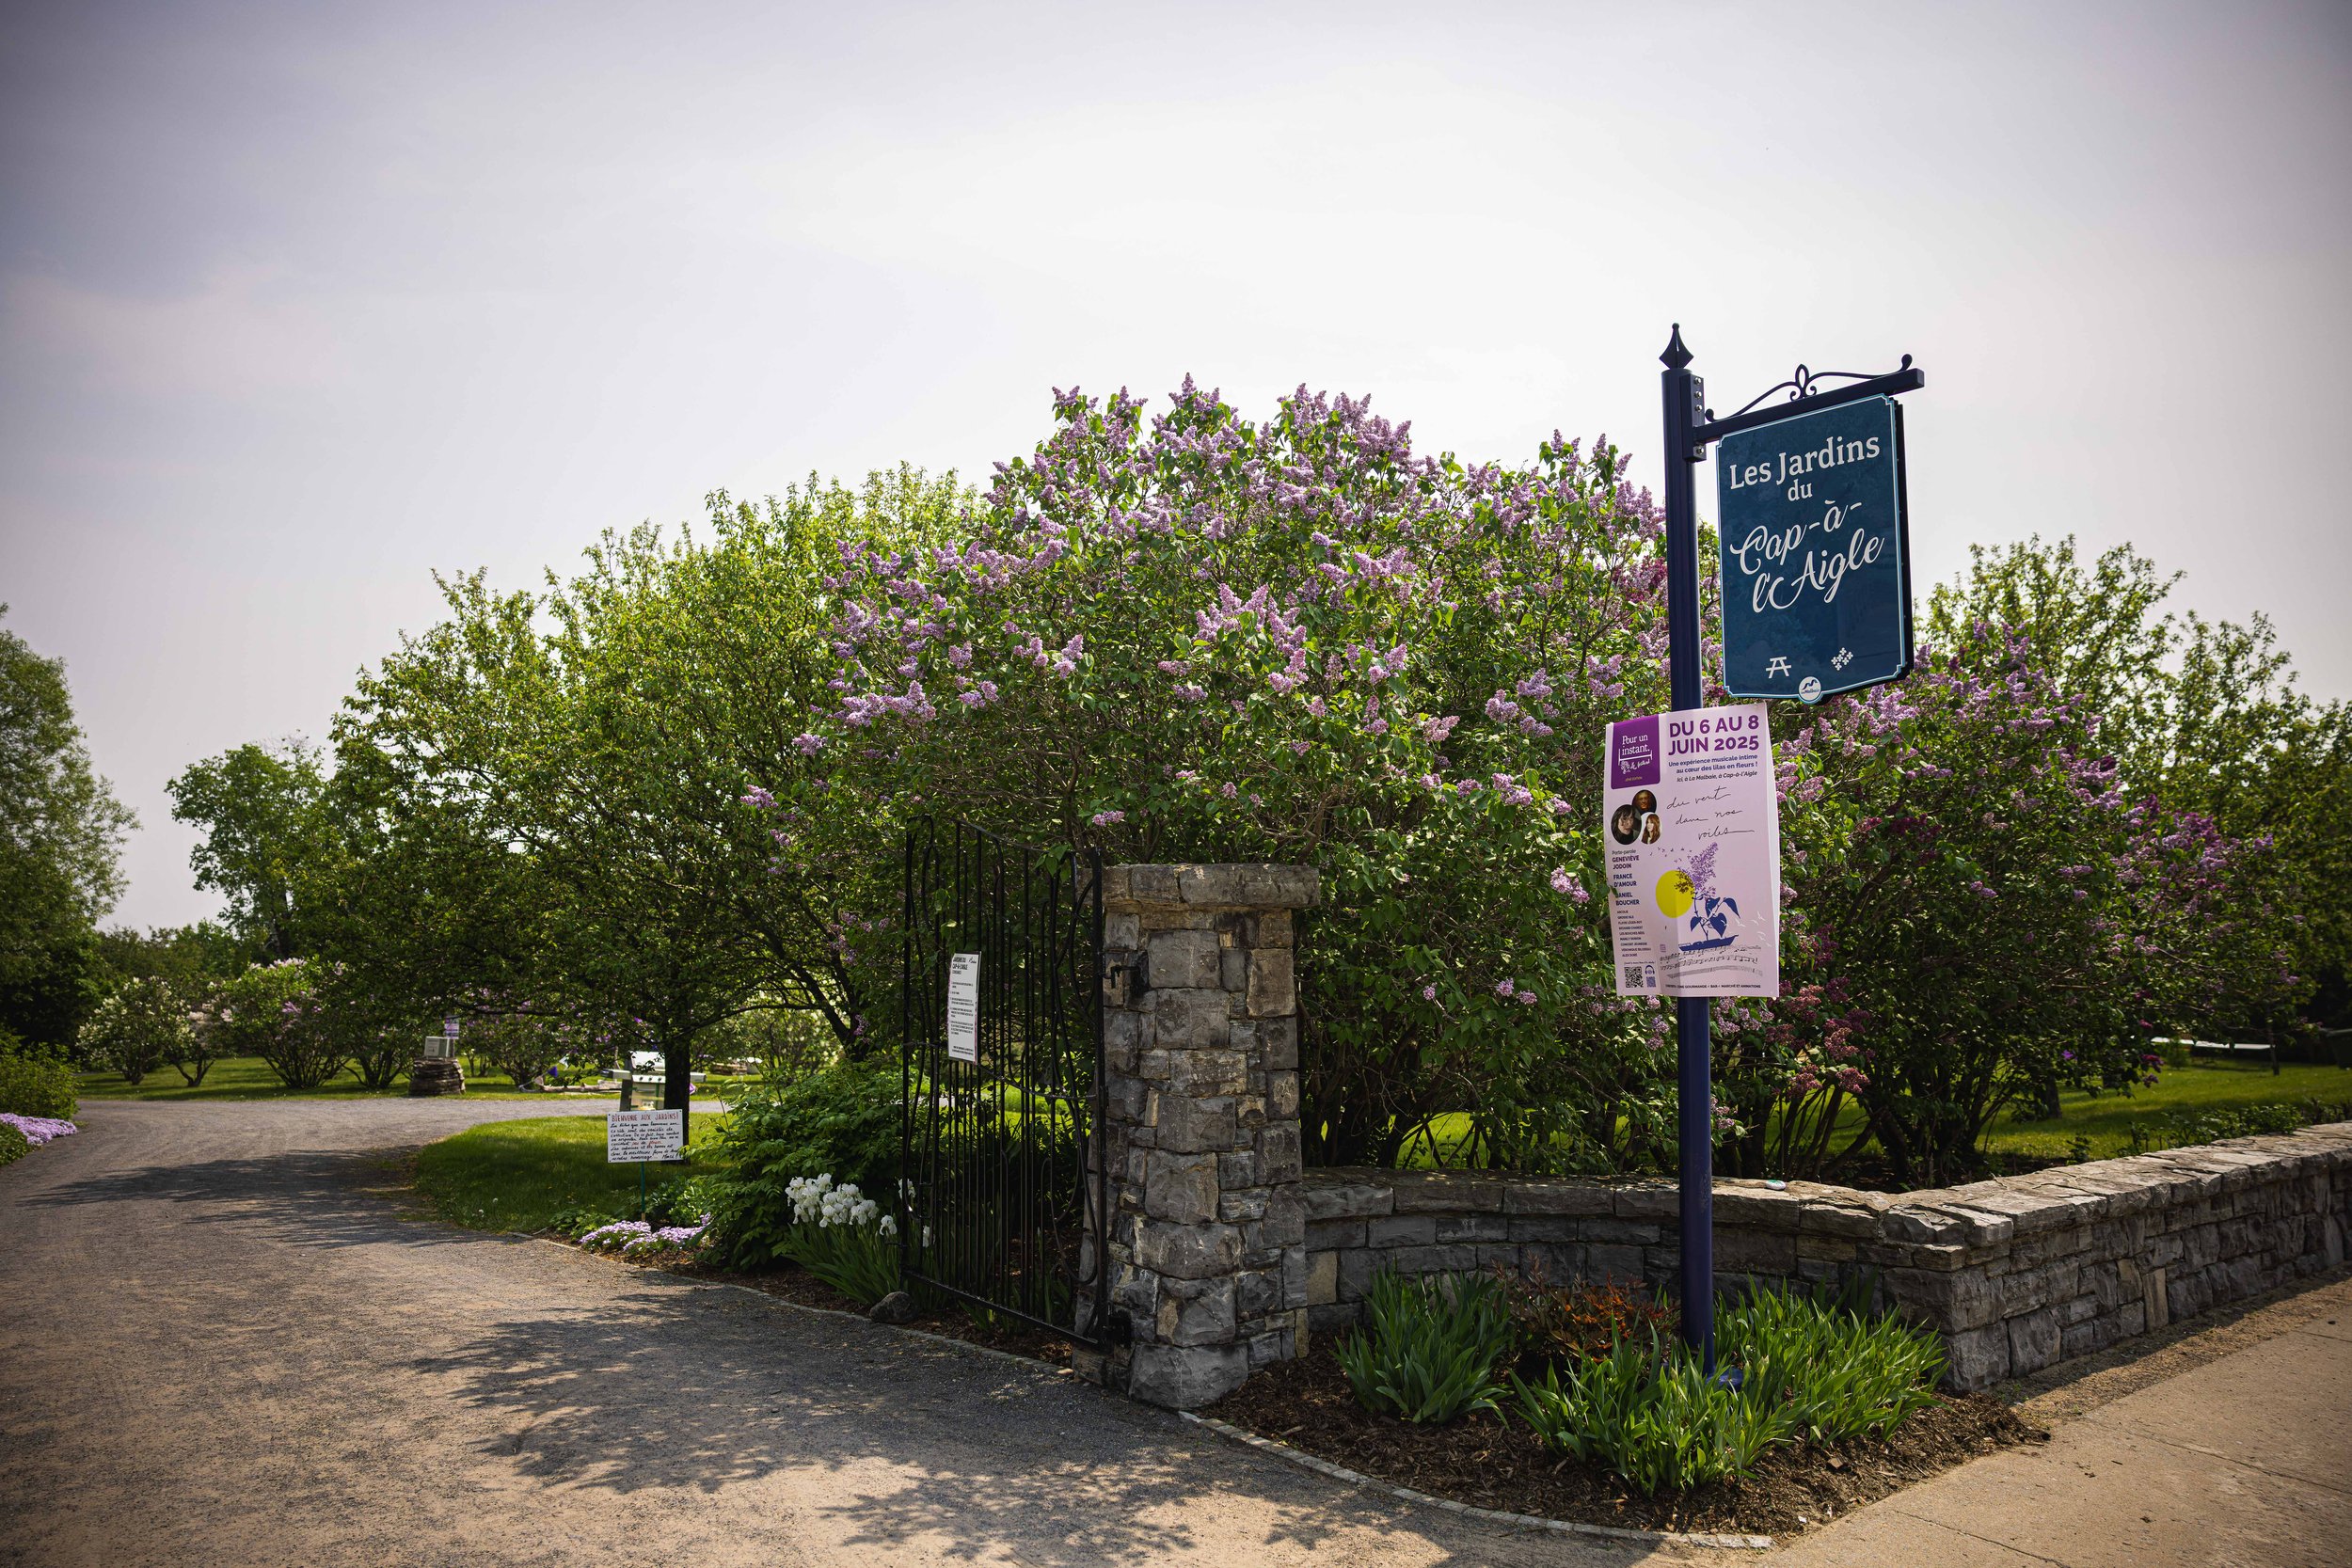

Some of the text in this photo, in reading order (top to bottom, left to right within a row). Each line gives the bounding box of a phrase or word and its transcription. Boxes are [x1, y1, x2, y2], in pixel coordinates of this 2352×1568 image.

[1730, 436, 1881, 490] Les Jardins
[1788, 479, 1813, 501] du
[1752, 528, 1884, 613] l'Aigle
[1670, 715, 1759, 737] DU 6 AU 8
[1622, 735, 1637, 745] Pour
[1622, 744, 1650, 755] instant.
[1668, 735, 1759, 755] JUIN 2025
[1666, 785, 1731, 809] du vent
[1676, 809, 1743, 825] dans nos
[1698, 825, 1755, 840] voiles
